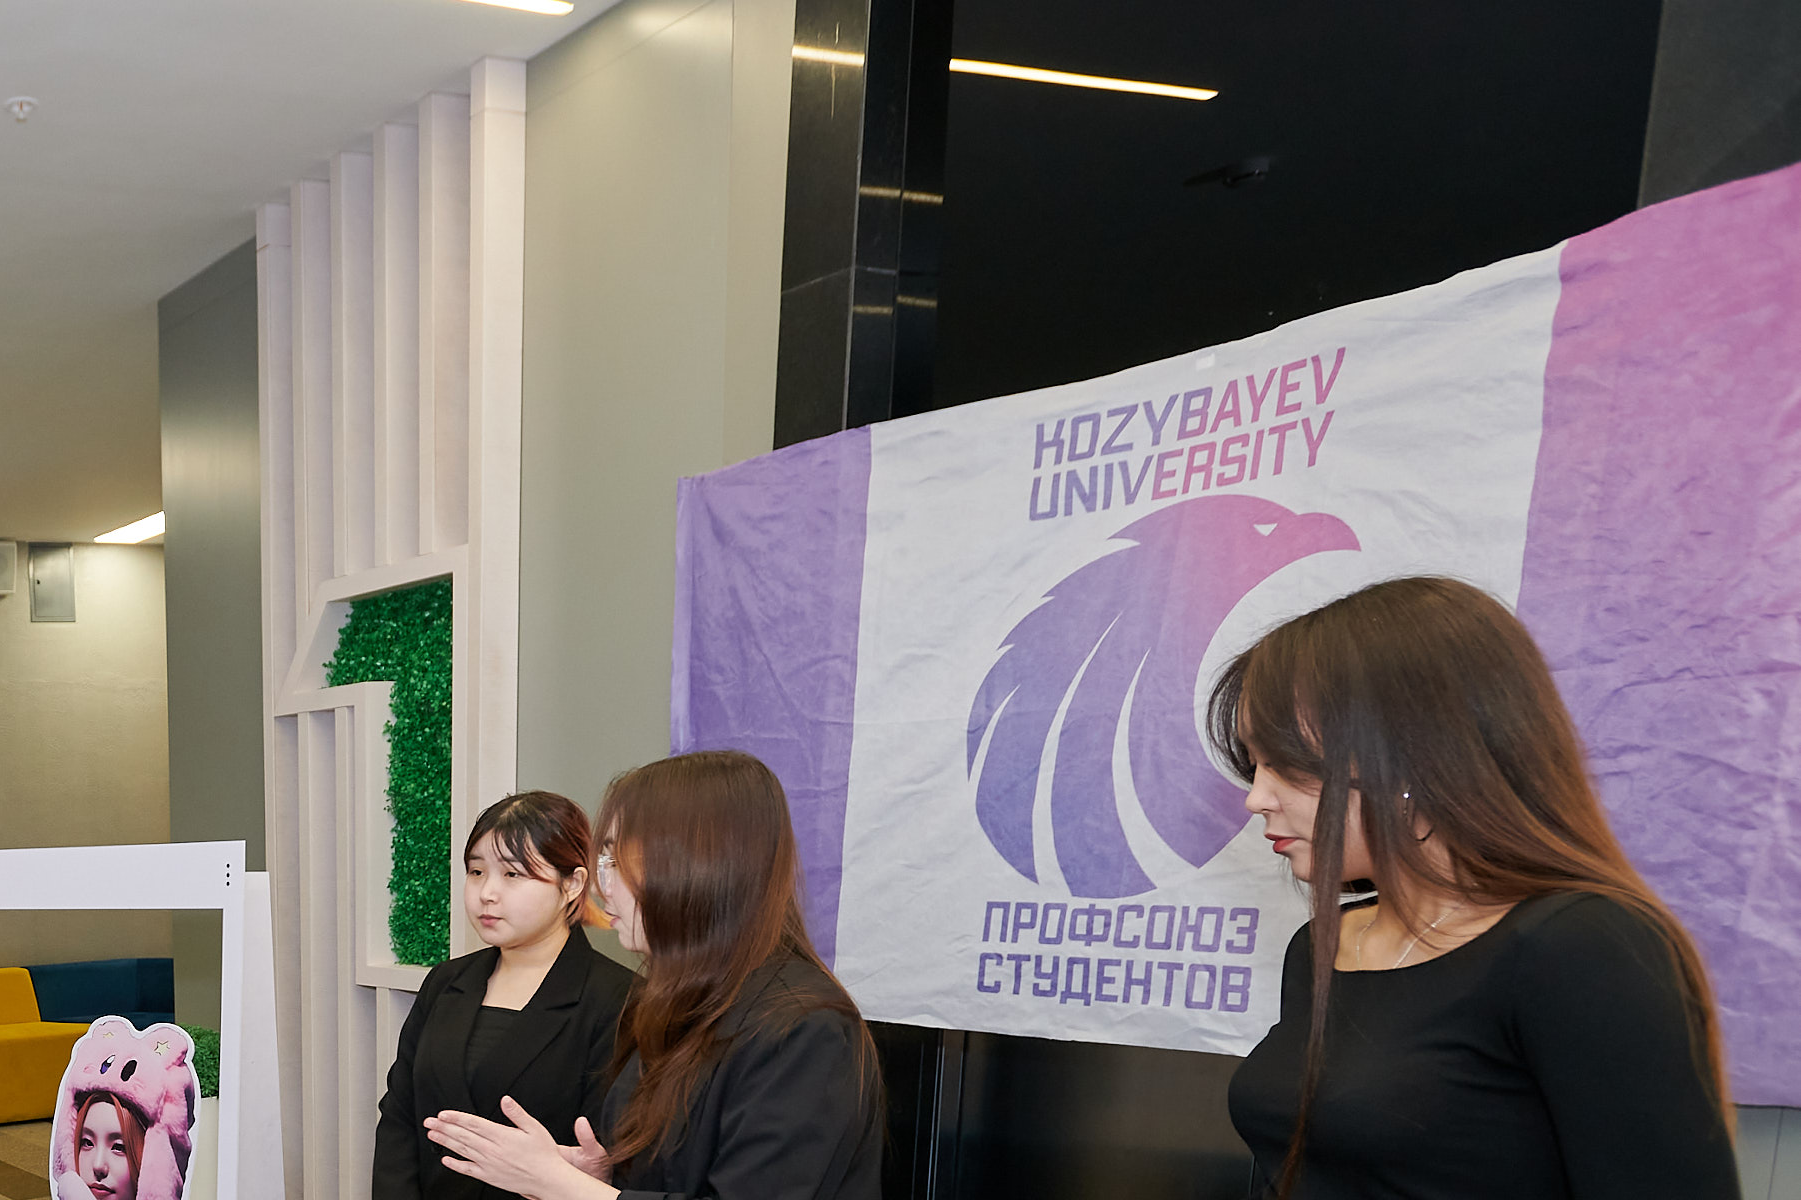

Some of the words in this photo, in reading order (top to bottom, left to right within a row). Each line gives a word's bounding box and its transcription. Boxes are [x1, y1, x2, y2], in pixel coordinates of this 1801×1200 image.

[1033, 347, 1346, 470] KOZYBAYEV
[1029, 411, 1335, 522] UNIVERSITY
[982, 901, 1259, 955] ПРОФСОЮЗ
[977, 953, 1252, 1013] СТУДЕНТОВ
